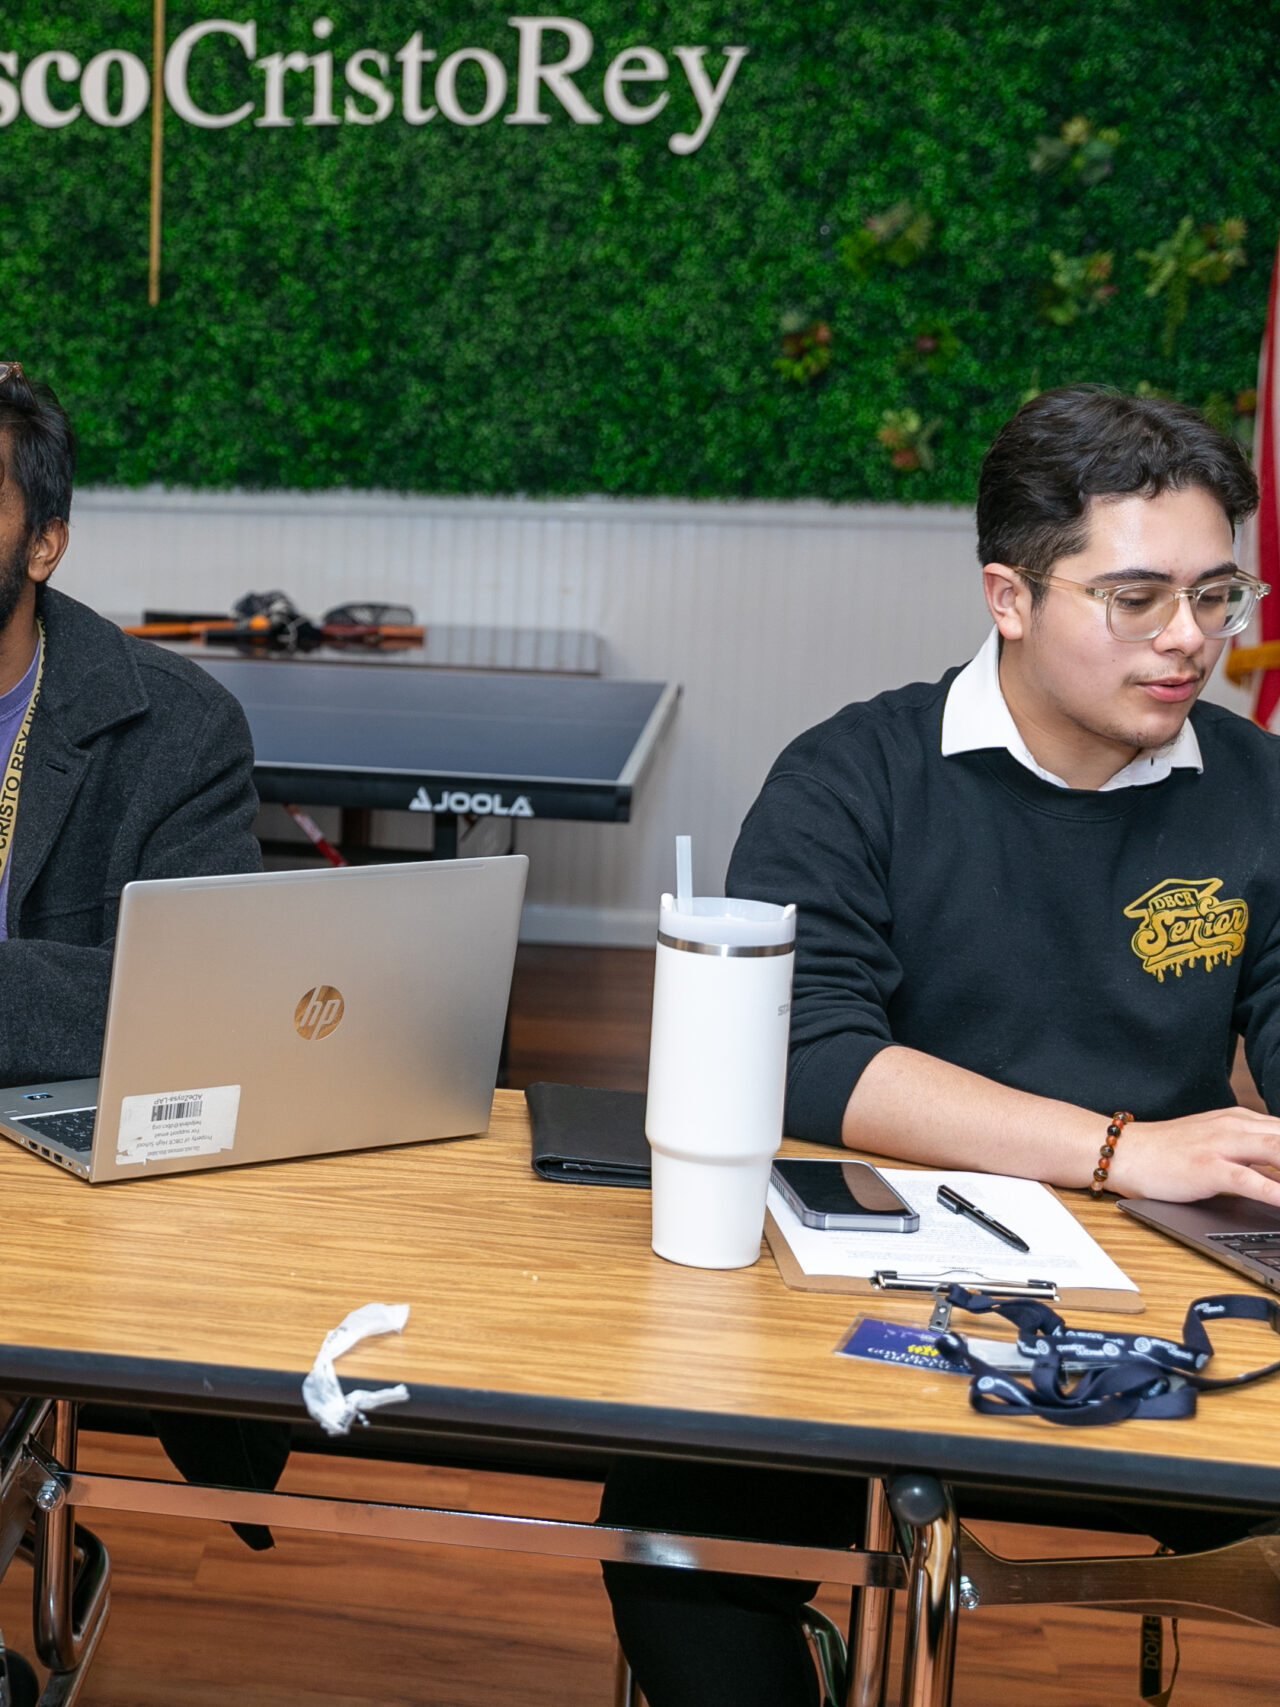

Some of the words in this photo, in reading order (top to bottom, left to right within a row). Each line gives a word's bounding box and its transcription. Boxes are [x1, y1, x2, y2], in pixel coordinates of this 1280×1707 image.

[10, 729, 30, 772] REY
[433, 791, 535, 817] JOOLA
[1154, 891, 1197, 910] DBCR
[1135, 898, 1247, 958] Senior
[299, 986, 341, 1041] hp
[1143, 1630, 1160, 1670] DON
